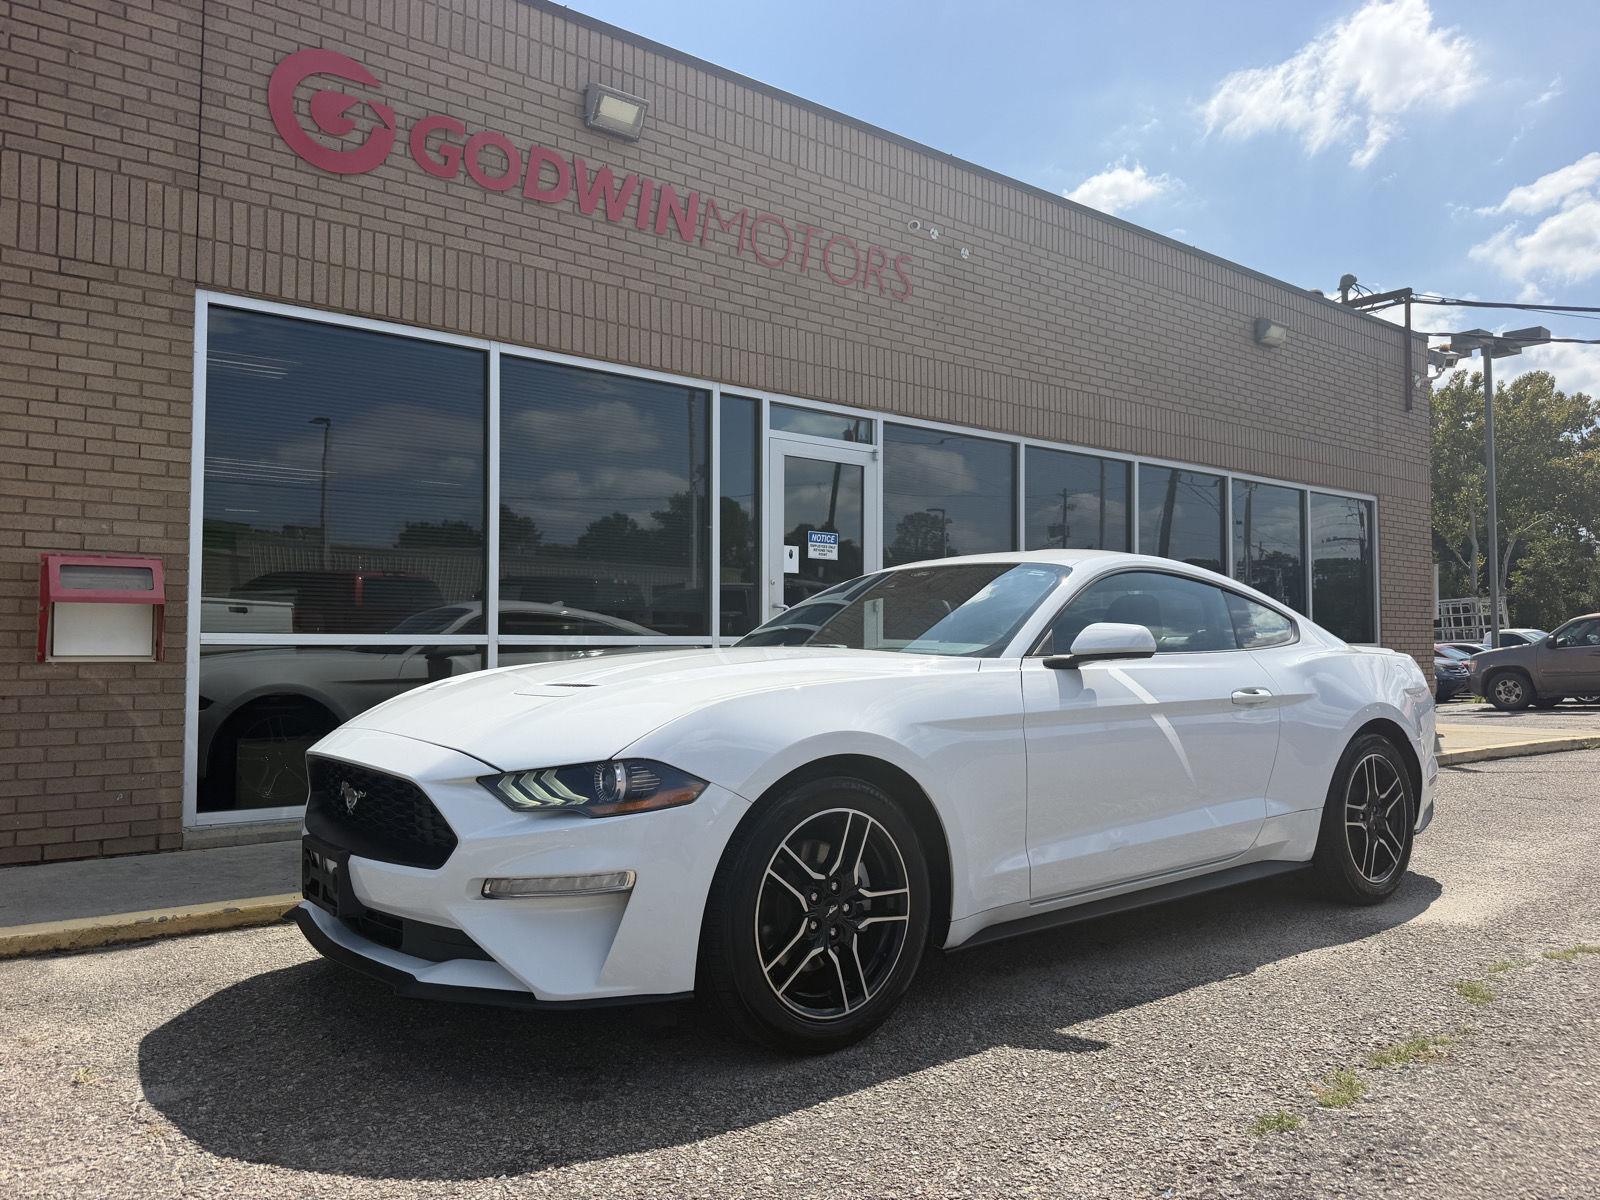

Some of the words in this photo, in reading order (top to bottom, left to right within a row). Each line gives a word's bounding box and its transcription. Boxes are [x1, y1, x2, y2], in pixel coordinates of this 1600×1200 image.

[409, 115, 699, 243] GODWIN
[700, 199, 914, 301] MOTORS
[811, 534, 836, 543] NOTICE
